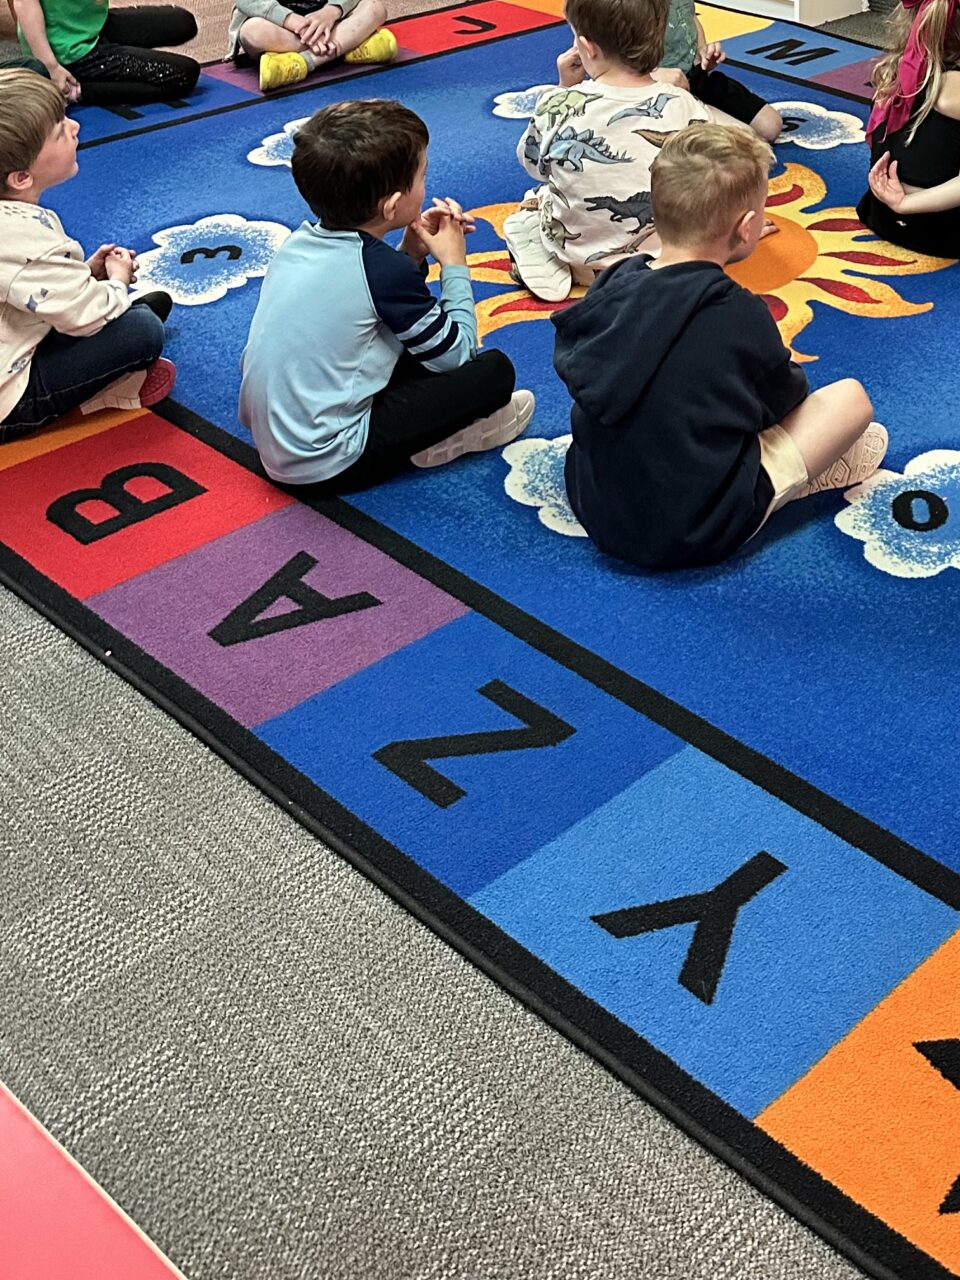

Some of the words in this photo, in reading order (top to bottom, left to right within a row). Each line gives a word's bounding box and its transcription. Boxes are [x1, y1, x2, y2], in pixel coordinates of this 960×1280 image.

[452, 15, 497, 36] J
[745, 38, 840, 66] M
[46, 461, 210, 546] B
[206, 549, 385, 648] A
[371, 677, 578, 810] Z
[588, 849, 789, 1006] Y
